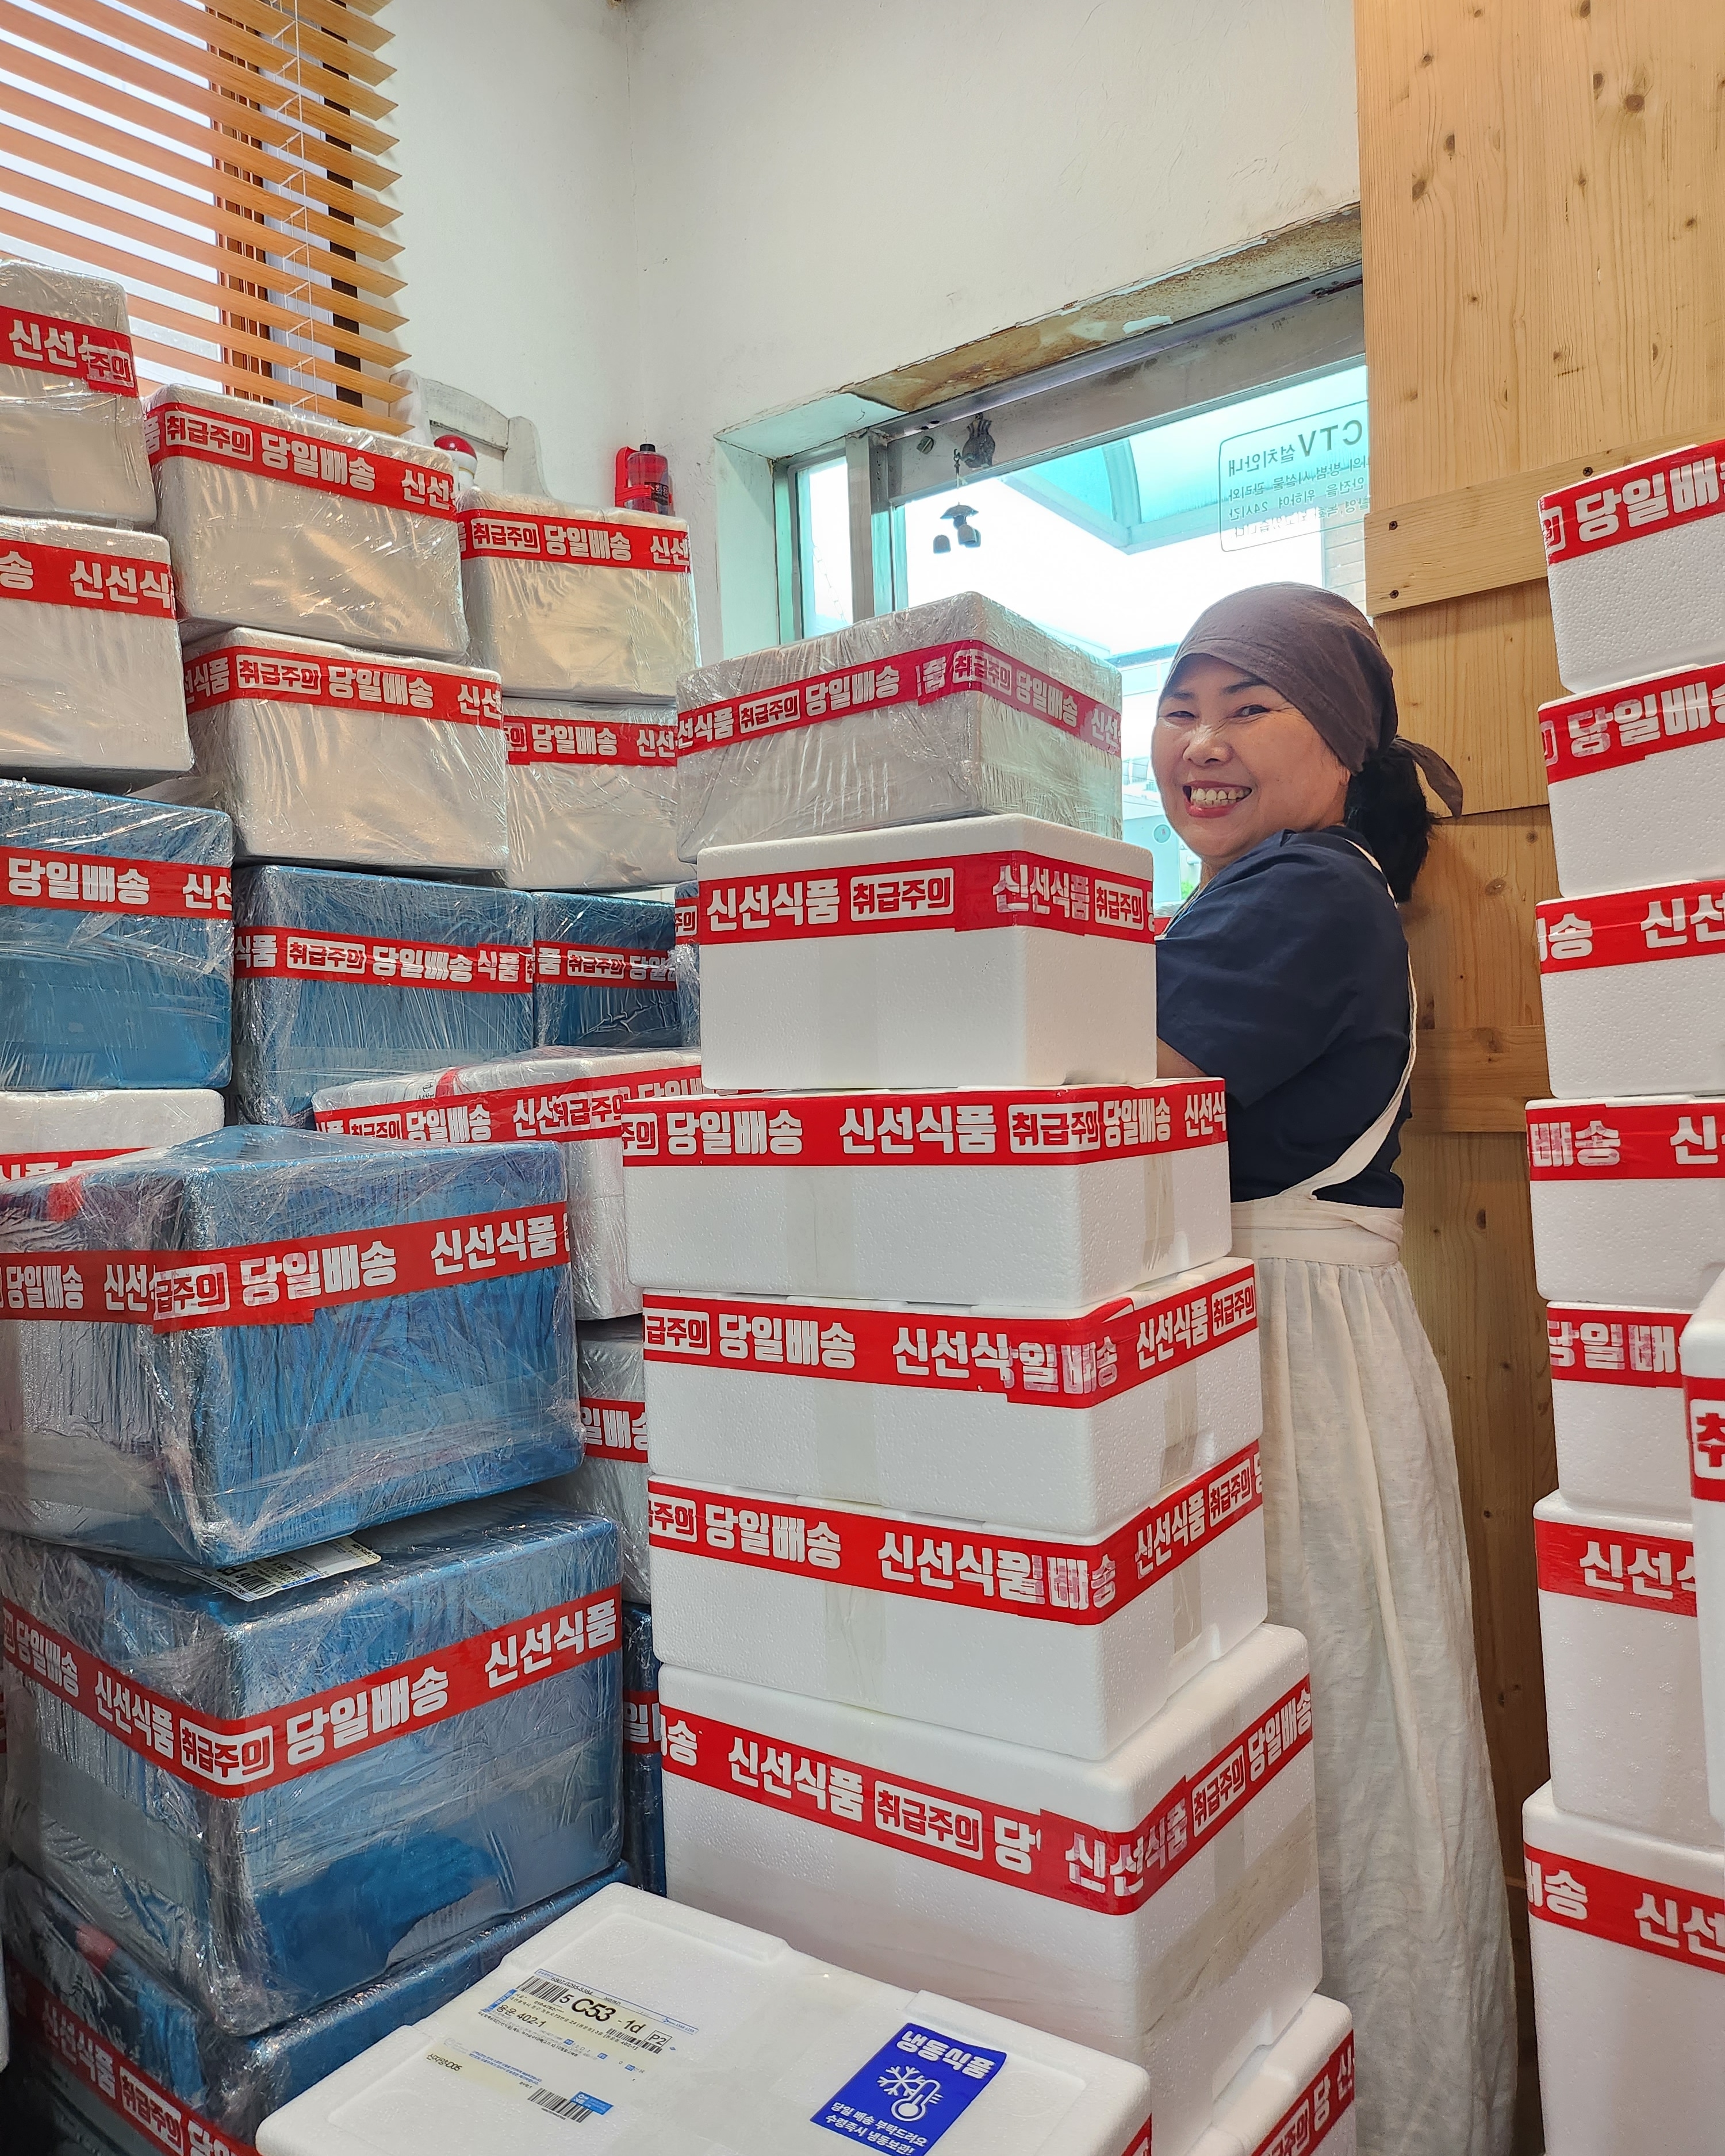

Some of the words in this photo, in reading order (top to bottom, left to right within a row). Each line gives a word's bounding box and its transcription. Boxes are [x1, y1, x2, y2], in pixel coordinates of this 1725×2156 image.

[166, 415, 252, 455] 취급주의
[260, 431, 376, 492] 당일배송
[401, 469, 455, 511] 신선
[1575, 456, 1725, 543] 당일배
[472, 522, 538, 547] 취급주의
[543, 524, 632, 561] 당일배송
[70, 559, 174, 609] 신선식
[239, 659, 320, 689] 취급주의
[327, 665, 434, 709] 당일배송
[741, 692, 799, 729] 취급주의
[806, 665, 900, 716] 당일배송
[954, 654, 1011, 692] 취급주의
[1015, 668, 1079, 728] 당일배송
[531, 723, 618, 756] 당일배송
[636, 729, 678, 759] 신선
[8, 857, 150, 906] 당일배송
[707, 878, 841, 932] 신선식품
[852, 876, 953, 916] 취급주의
[992, 864, 1090, 921] 신선식품
[1096, 887, 1143, 924] 취급주의
[289, 942, 365, 969] 취급주의
[373, 945, 473, 983] 당일배송
[568, 954, 624, 977] 취급주의
[406, 1104, 491, 1143] 당일배송
[666, 1108, 803, 1156] 당일배송
[838, 1104, 995, 1154] 신선식품
[1010, 1108, 1099, 1150] 취급주의
[1103, 1096, 1171, 1149] 당일배송
[6, 1265, 83, 1310] 당일배송
[240, 1241, 397, 1306] 당일배송
[431, 1217, 557, 1276] 신선식품
[643, 1315, 708, 1349] 급주의
[718, 1314, 855, 1369] 당일배송
[1136, 1296, 1207, 1370] 신선식품
[1214, 1284, 1256, 1330] 취급주의
[1548, 1320, 1681, 1373] 당일배
[704, 1502, 841, 1569] 당일배송
[1135, 1494, 1205, 1571] 신선식품
[1209, 1467, 1251, 1518] 취급주의
[16, 1618, 79, 1698] 당일배송
[94, 1667, 174, 1758] 신선식품
[181, 1724, 271, 1779] 취급주의
[286, 1665, 450, 1762] 당일배송
[484, 1598, 617, 1690] 신선식품
[727, 1736, 865, 1821] 신선식품
[877, 1789, 980, 1848] 취급주의
[1065, 1797, 1188, 1897] 신선식품
[1194, 1752, 1245, 1827] 취급주의
[1248, 1687, 1313, 1782] 당일배송
[516, 2012, 547, 2028] 402-1
[559, 1994, 574, 2004] 5
[571, 1998, 616, 2022] C53
[622, 2019, 647, 2034] 1d
[647, 2034, 667, 2046] P2
[43, 2000, 116, 2100] 신선식품
[121, 2075, 182, 2152] 취급주의
[896, 2030, 996, 2080] 냉동식품
[825, 2115, 867, 2138] 수령즉시
[867, 2131, 915, 2156] 냉동보관!
[830, 2101, 854, 2117] 당일
[854, 2111, 876, 2126] 배송
[875, 2119, 929, 2147] 부탁드려요
